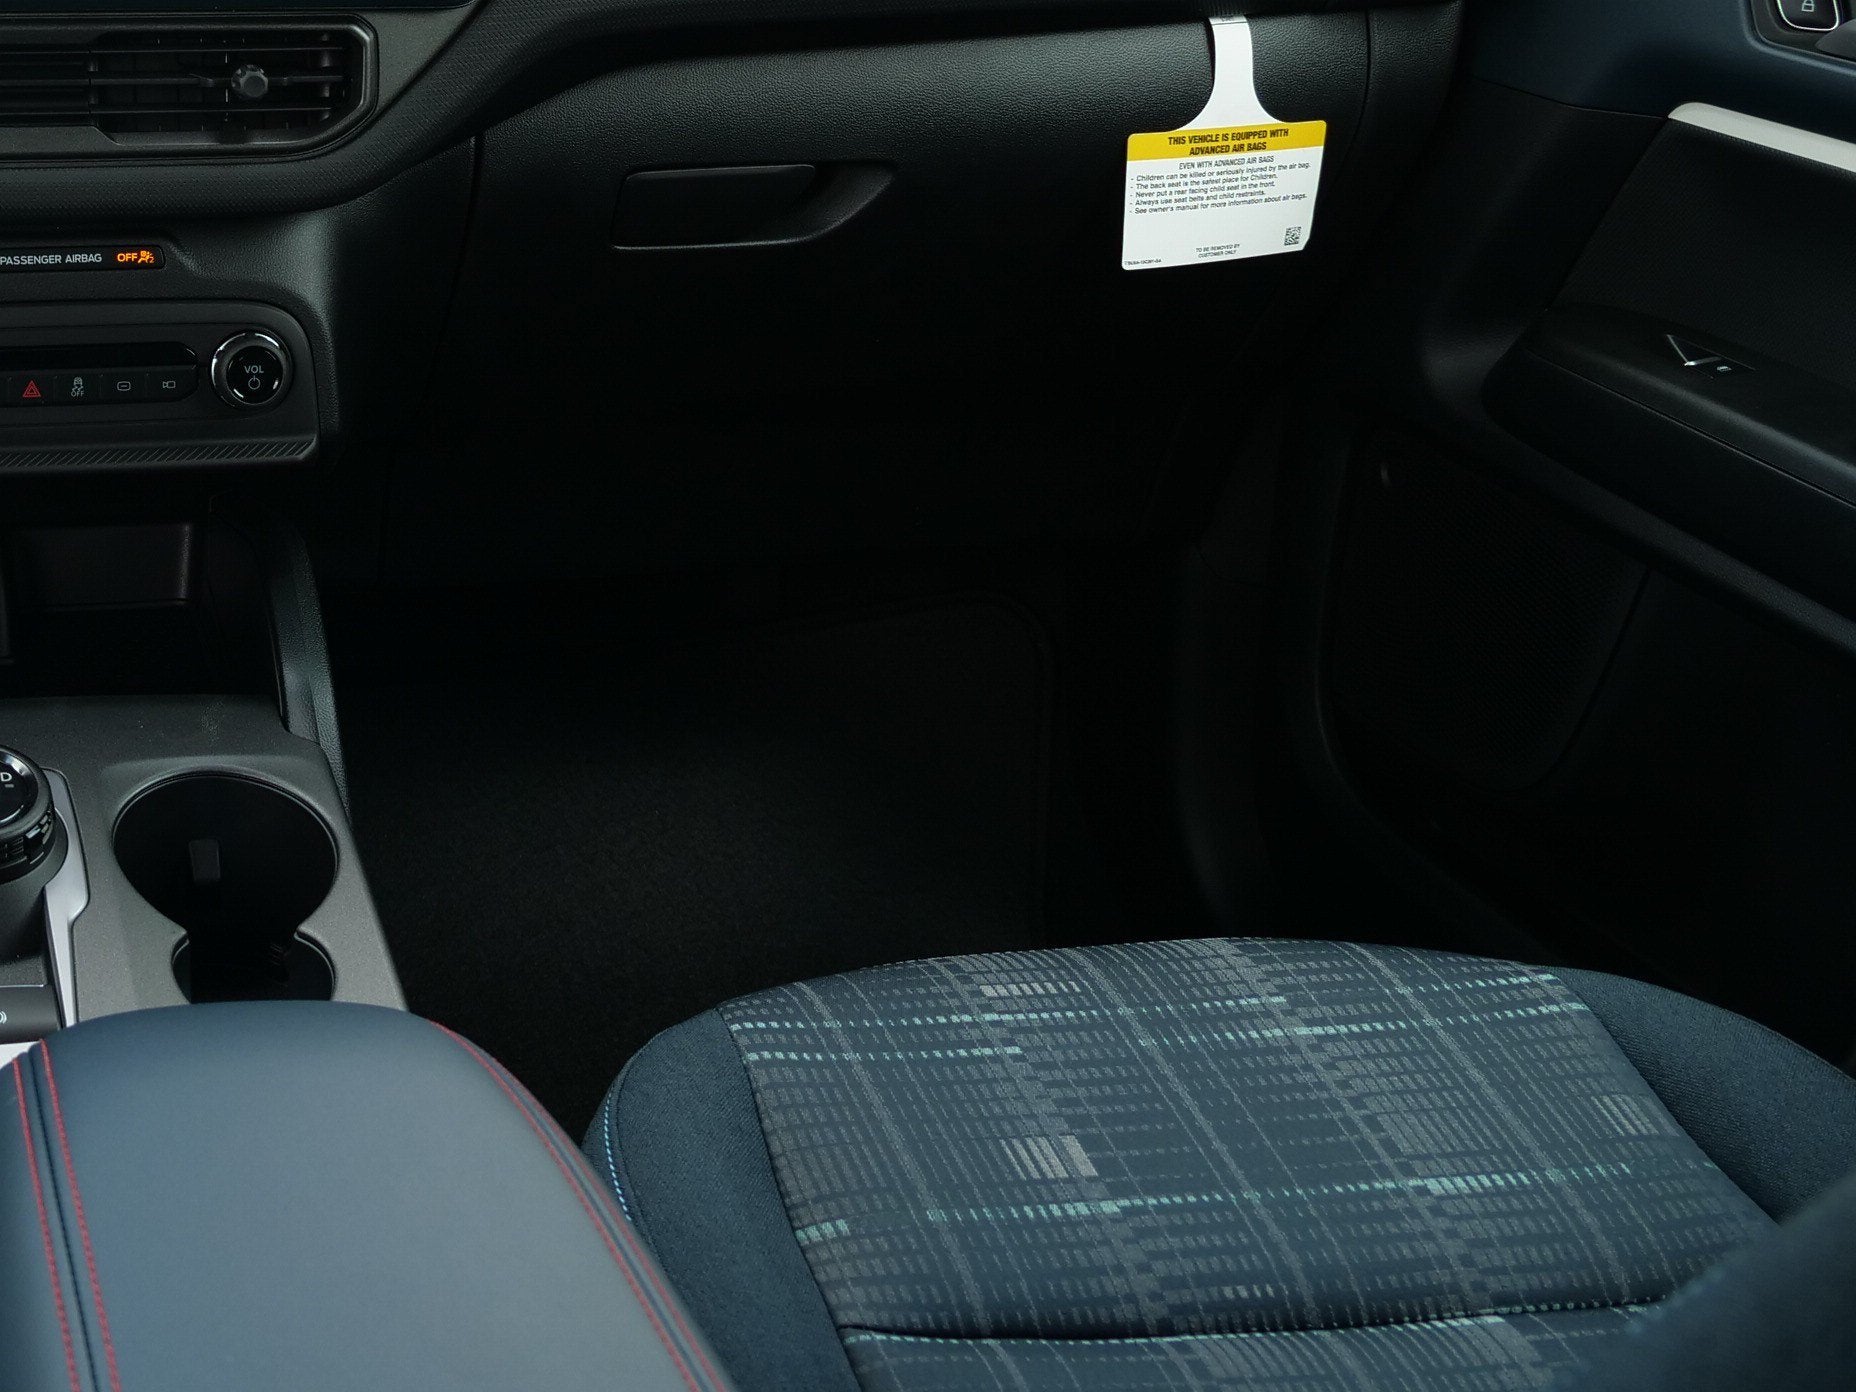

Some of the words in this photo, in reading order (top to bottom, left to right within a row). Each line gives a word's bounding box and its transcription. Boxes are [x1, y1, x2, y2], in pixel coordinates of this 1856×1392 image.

[1168, 136, 1186, 145] THIS
[1189, 134, 1220, 144] VEHICLE
[1222, 133, 1229, 141] IS
[1231, 130, 1268, 140] EQUIPPED
[1270, 128, 1289, 138] WITH
[1189, 145, 1230, 155] ADVANCED
[1232, 144, 1245, 152] AIR
[1247, 142, 1267, 151] BAGS
[1179, 162, 1195, 170] EVEN
[0, 254, 62, 266] PASSENGER
[65, 253, 102, 264] AIRBAG
[117, 252, 138, 262] OFF
[244, 365, 264, 374] VOL
[0, 772, 12, 781] D
